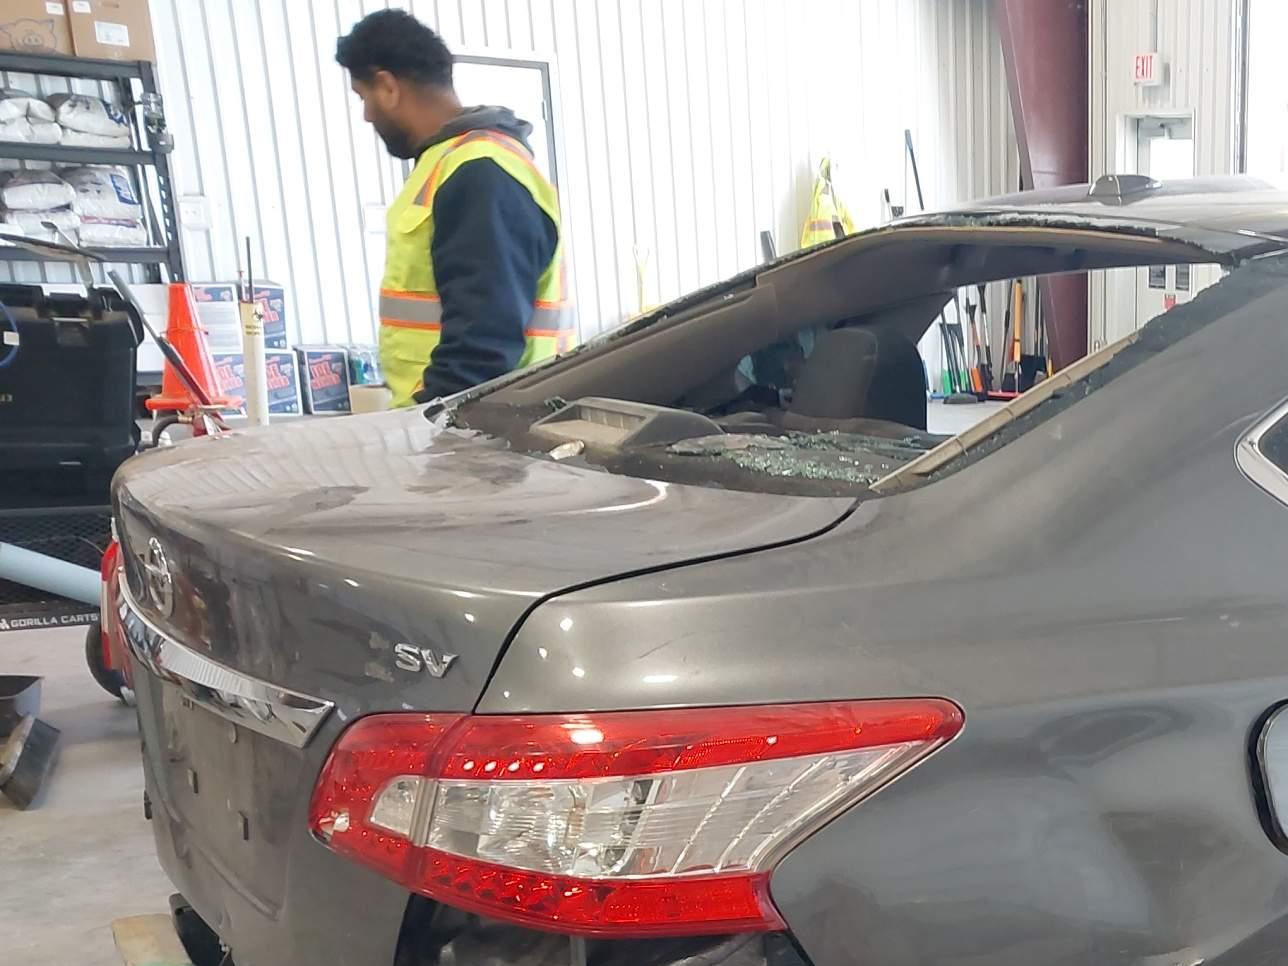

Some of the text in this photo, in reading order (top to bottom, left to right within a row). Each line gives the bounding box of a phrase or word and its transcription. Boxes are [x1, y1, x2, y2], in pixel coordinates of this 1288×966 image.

[1135, 55, 1153, 79] EXIT
[10, 612, 98, 628] GORILLA CARTS
[394, 643, 460, 677] SV
